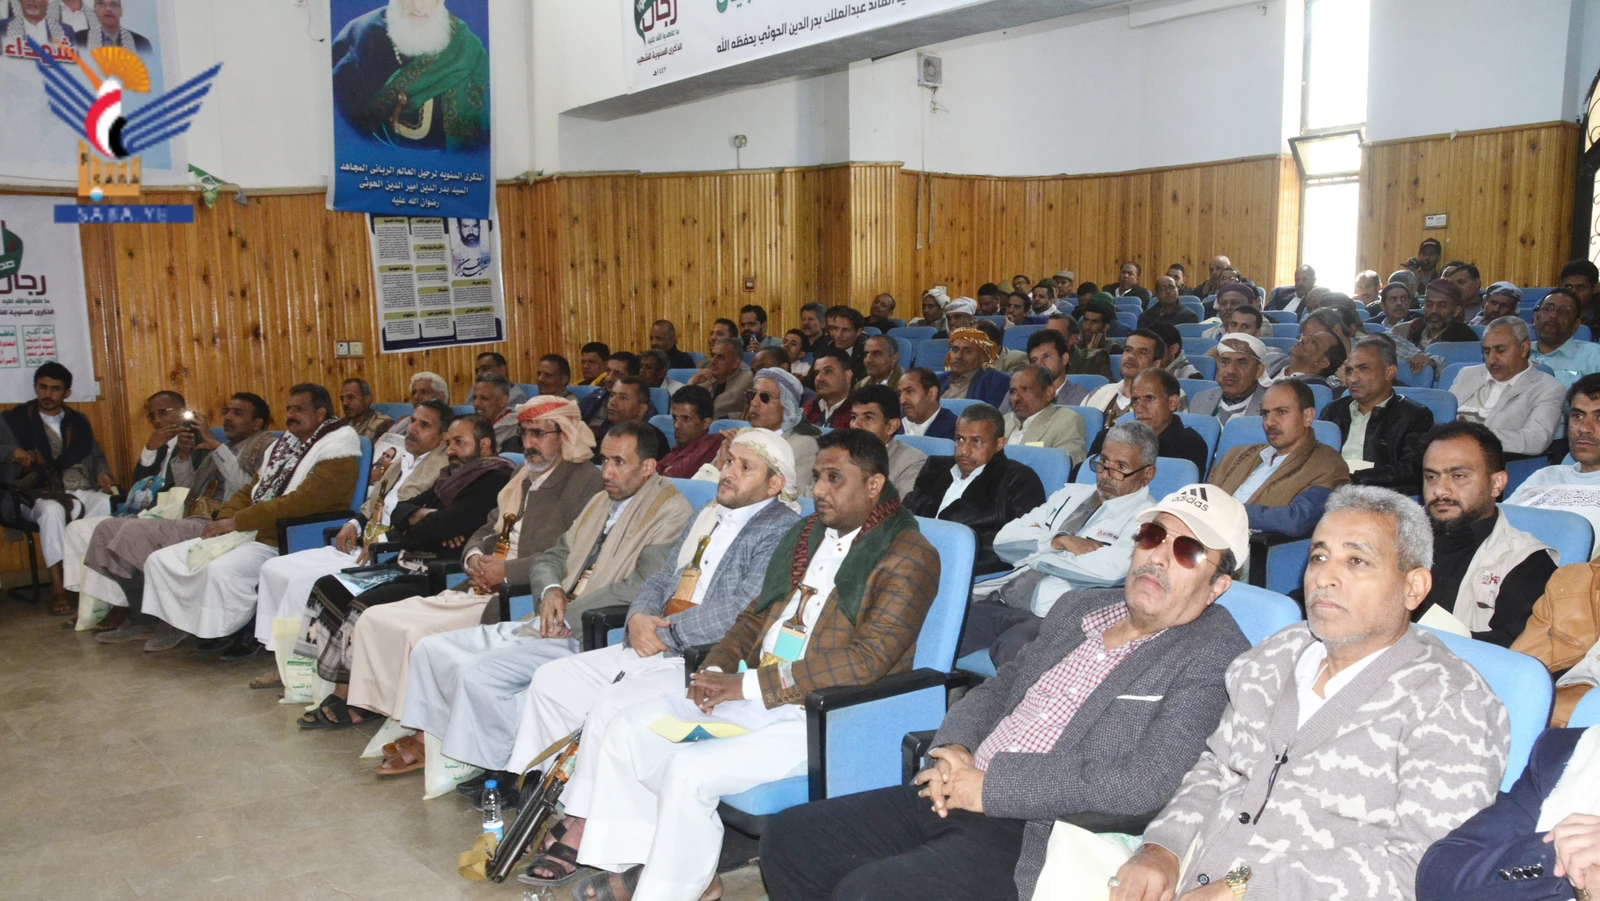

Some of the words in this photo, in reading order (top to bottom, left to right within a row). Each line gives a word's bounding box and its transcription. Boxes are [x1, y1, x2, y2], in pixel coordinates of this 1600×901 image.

[824, 4, 867, 23] عبدالملك
[788, 16, 810, 36] الدين
[810, 15, 822, 30] بدر
[758, 23, 787, 42] الحوثي
[716, 36, 730, 53] الله
[731, 33, 757, 48] يحفظه
[340, 162, 368, 173] المجاهد
[396, 166, 416, 177] العالم
[417, 168, 438, 180] لرحيل
[463, 172, 485, 183] الذكرى
[385, 181, 404, 192] الدين
[420, 183, 438, 194] الدين
[391, 196, 406, 206] عليه
[408, 196, 419, 206] الله
[420, 198, 440, 208] رضوان
[1171, 494, 1209, 512] adidas
